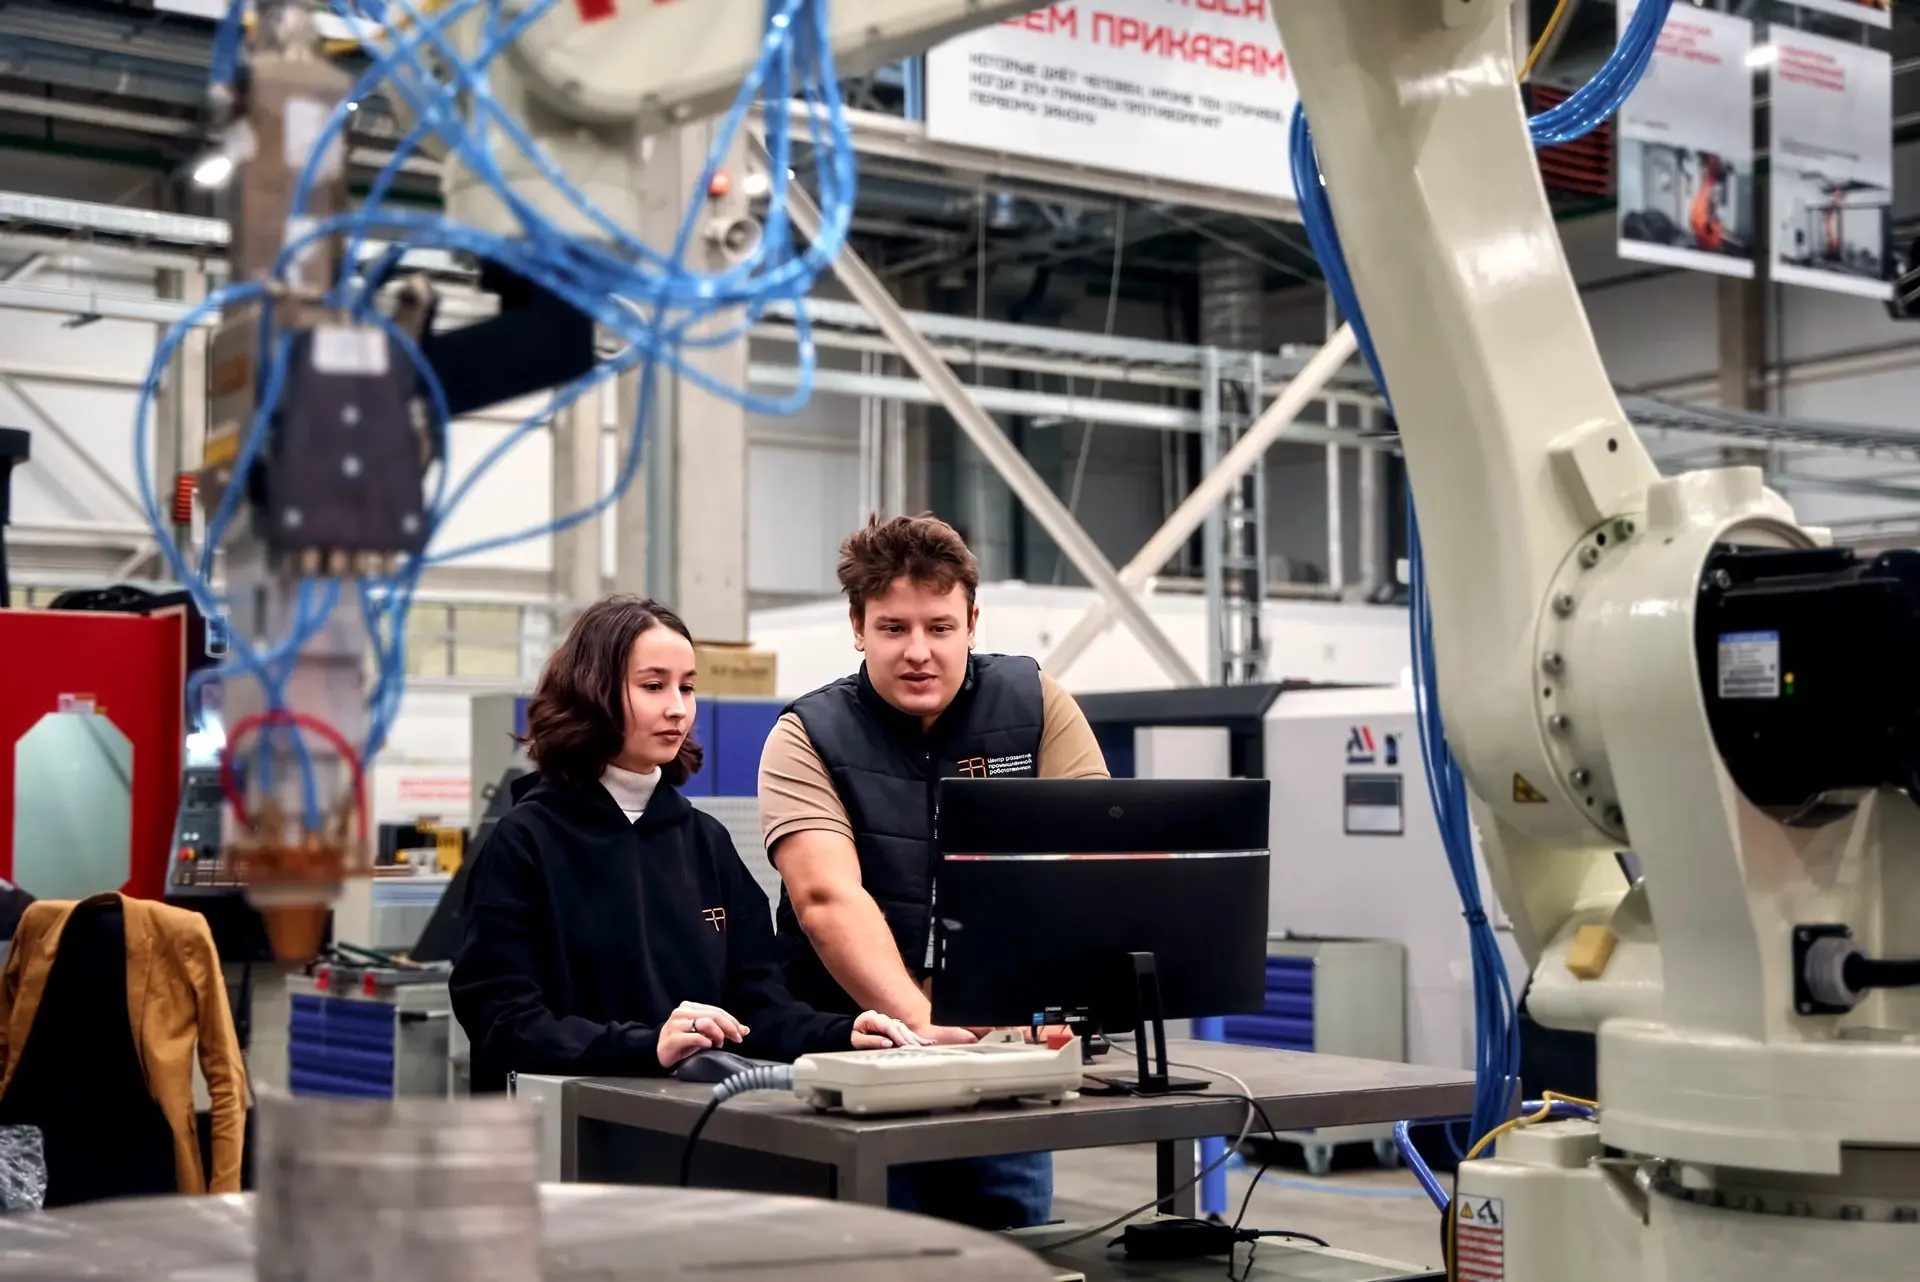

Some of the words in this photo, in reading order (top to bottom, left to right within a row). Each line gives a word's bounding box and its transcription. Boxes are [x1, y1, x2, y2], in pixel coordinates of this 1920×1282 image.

[1004, 5, 1077, 40] ЕМ
[1092, 11, 1287, 81] ПРИКАЗАМ
[1005, 753, 1031, 762] развития
[988, 758, 1032, 769] промышленной
[989, 765, 1031, 775] робототехники
